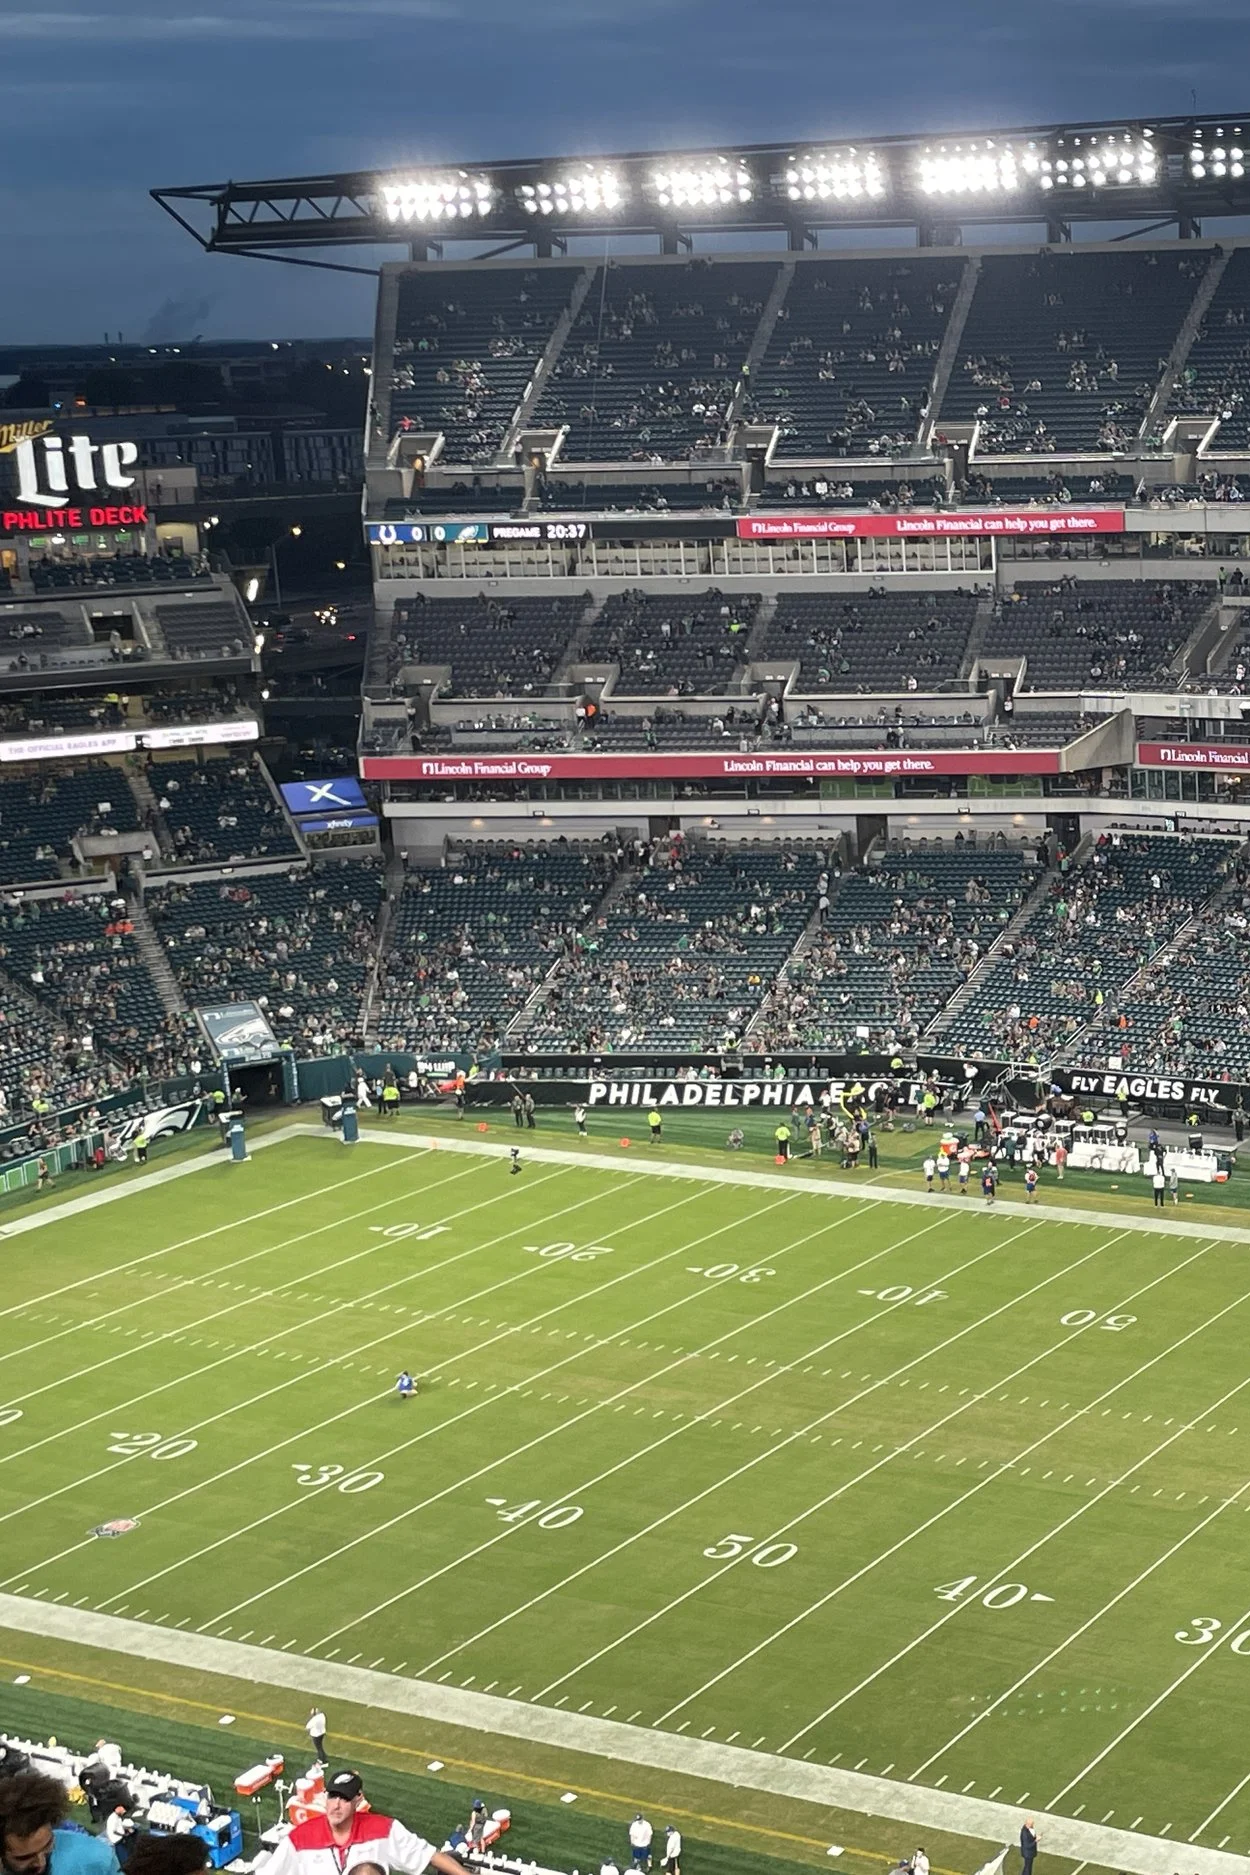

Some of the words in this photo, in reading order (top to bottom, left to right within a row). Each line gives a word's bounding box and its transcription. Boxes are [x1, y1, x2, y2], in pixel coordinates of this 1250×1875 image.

[0, 420, 54, 446] Miller
[14, 436, 138, 508] Lite
[3, 508, 83, 530] PHLITE
[90, 505, 148, 526] DECK
[897, 519, 935, 531] Lincoln
[936, 518, 983, 530] Financial
[984, 521, 1003, 529] can
[1005, 518, 1027, 531] help
[1029, 520, 1048, 531] you
[1050, 519, 1065, 531] get
[1067, 517, 1097, 527] there.
[412, 527, 422, 541] 0
[434, 526, 445, 540] 0
[493, 527, 541, 538] PREGAME
[547, 524, 586, 539] 20:37
[724, 760, 763, 771] Lincoln
[766, 760, 814, 771] Financial
[816, 762, 835, 770] can
[837, 759, 861, 772] help
[863, 762, 883, 772] you
[885, 761, 901, 772] get
[903, 758, 934, 769] there.
[1171, 749, 1207, 763] Lincoln
[1208, 751, 1249, 764] Financial
[434, 762, 473, 775] Lincoln
[474, 762, 516, 774] Financial
[518, 762, 551, 776] Group
[589, 1083, 815, 1106] PHILADELPHIA
[1071, 1076, 1099, 1092] FLY
[1103, 1075, 1185, 1100] EAGLES
[1190, 1087, 1220, 1103] FLY
[382, 1222, 452, 1240] 10
[538, 1242, 615, 1261] 20
[703, 1263, 776, 1283] 30
[876, 1285, 949, 1306] 40
[1059, 1309, 1138, 1332] 50
[107, 1432, 199, 1460] 20
[297, 1464, 385, 1493] 30
[498, 1500, 584, 1529] 40
[702, 1534, 798, 1568] 50
[933, 1575, 1028, 1609] 40
